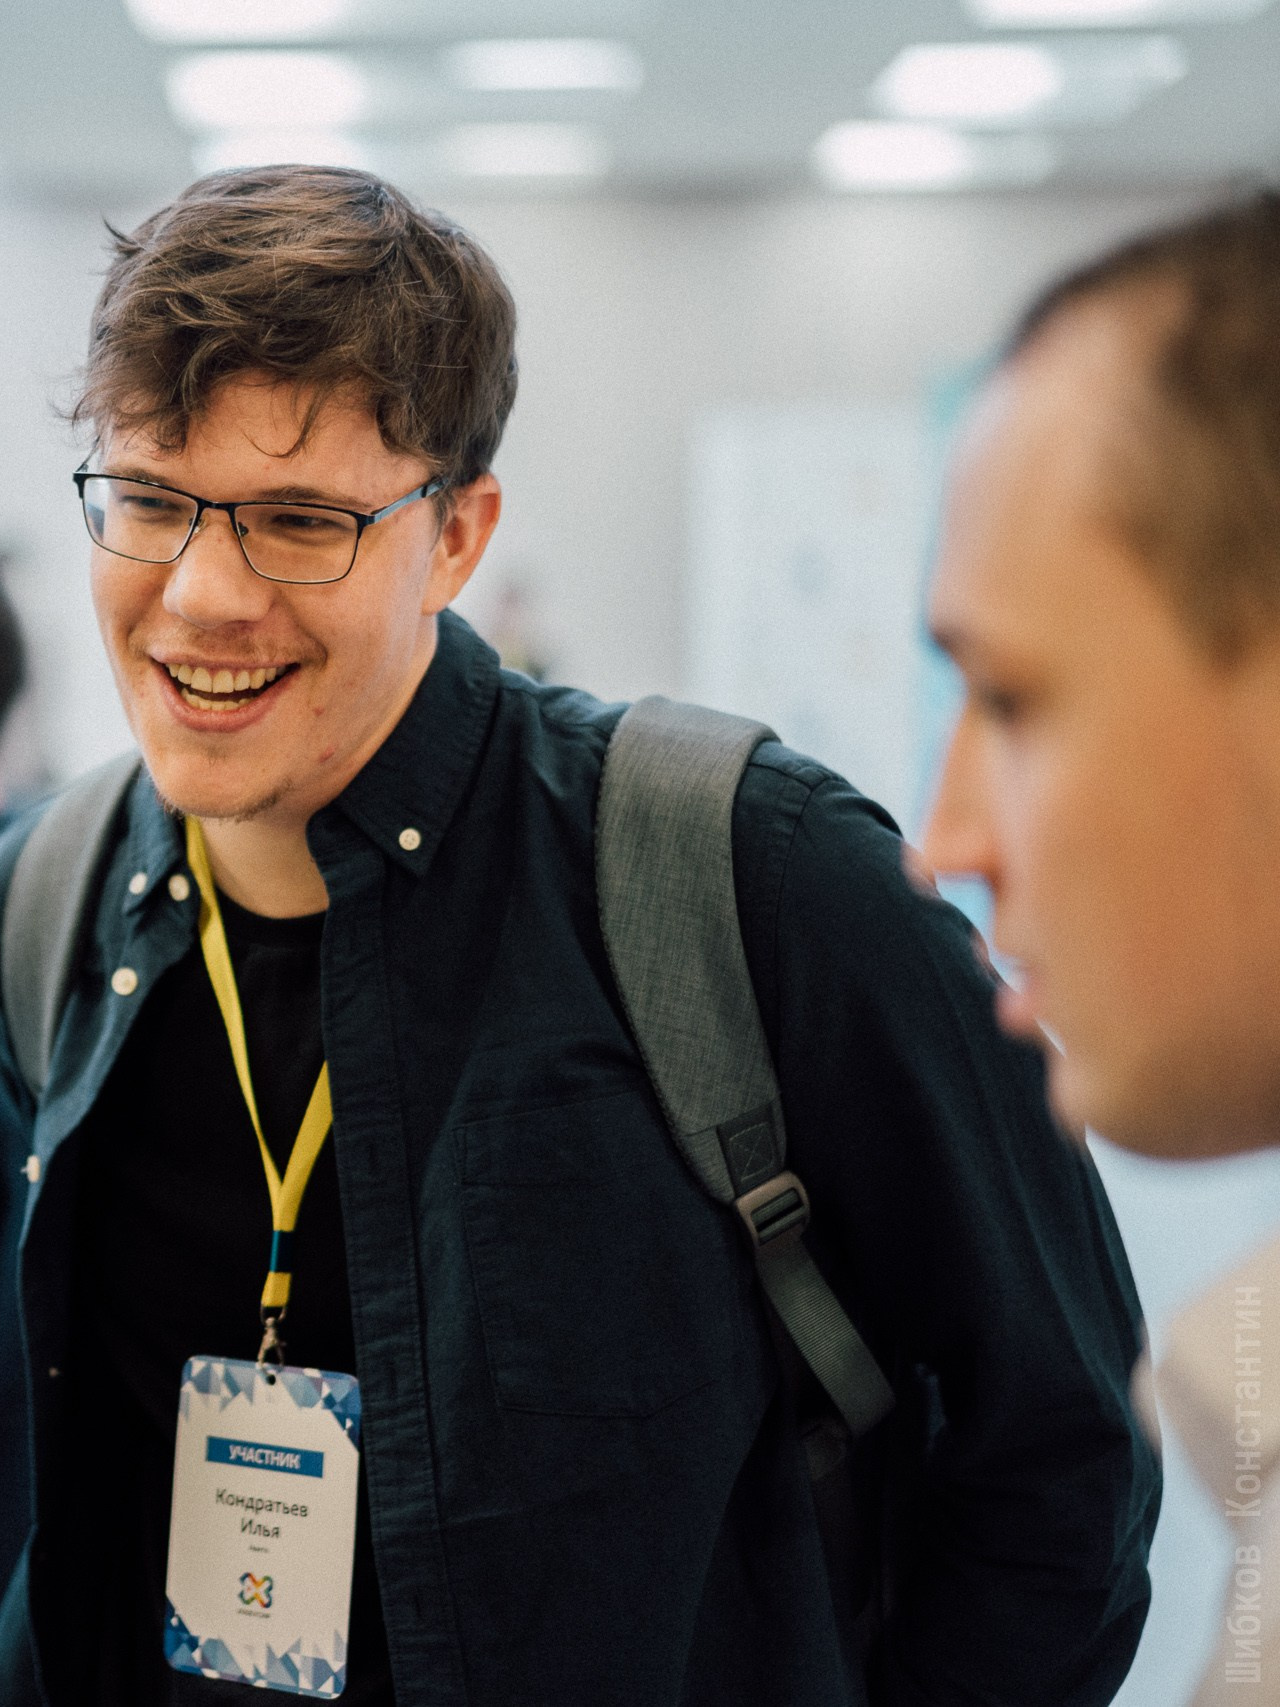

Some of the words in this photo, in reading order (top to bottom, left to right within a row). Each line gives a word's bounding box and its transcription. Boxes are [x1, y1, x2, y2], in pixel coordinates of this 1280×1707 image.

[228, 1444, 301, 1470] УЧАСТНИК
[215, 1487, 308, 1517] Кондратьев
[240, 1517, 281, 1538] Илья
